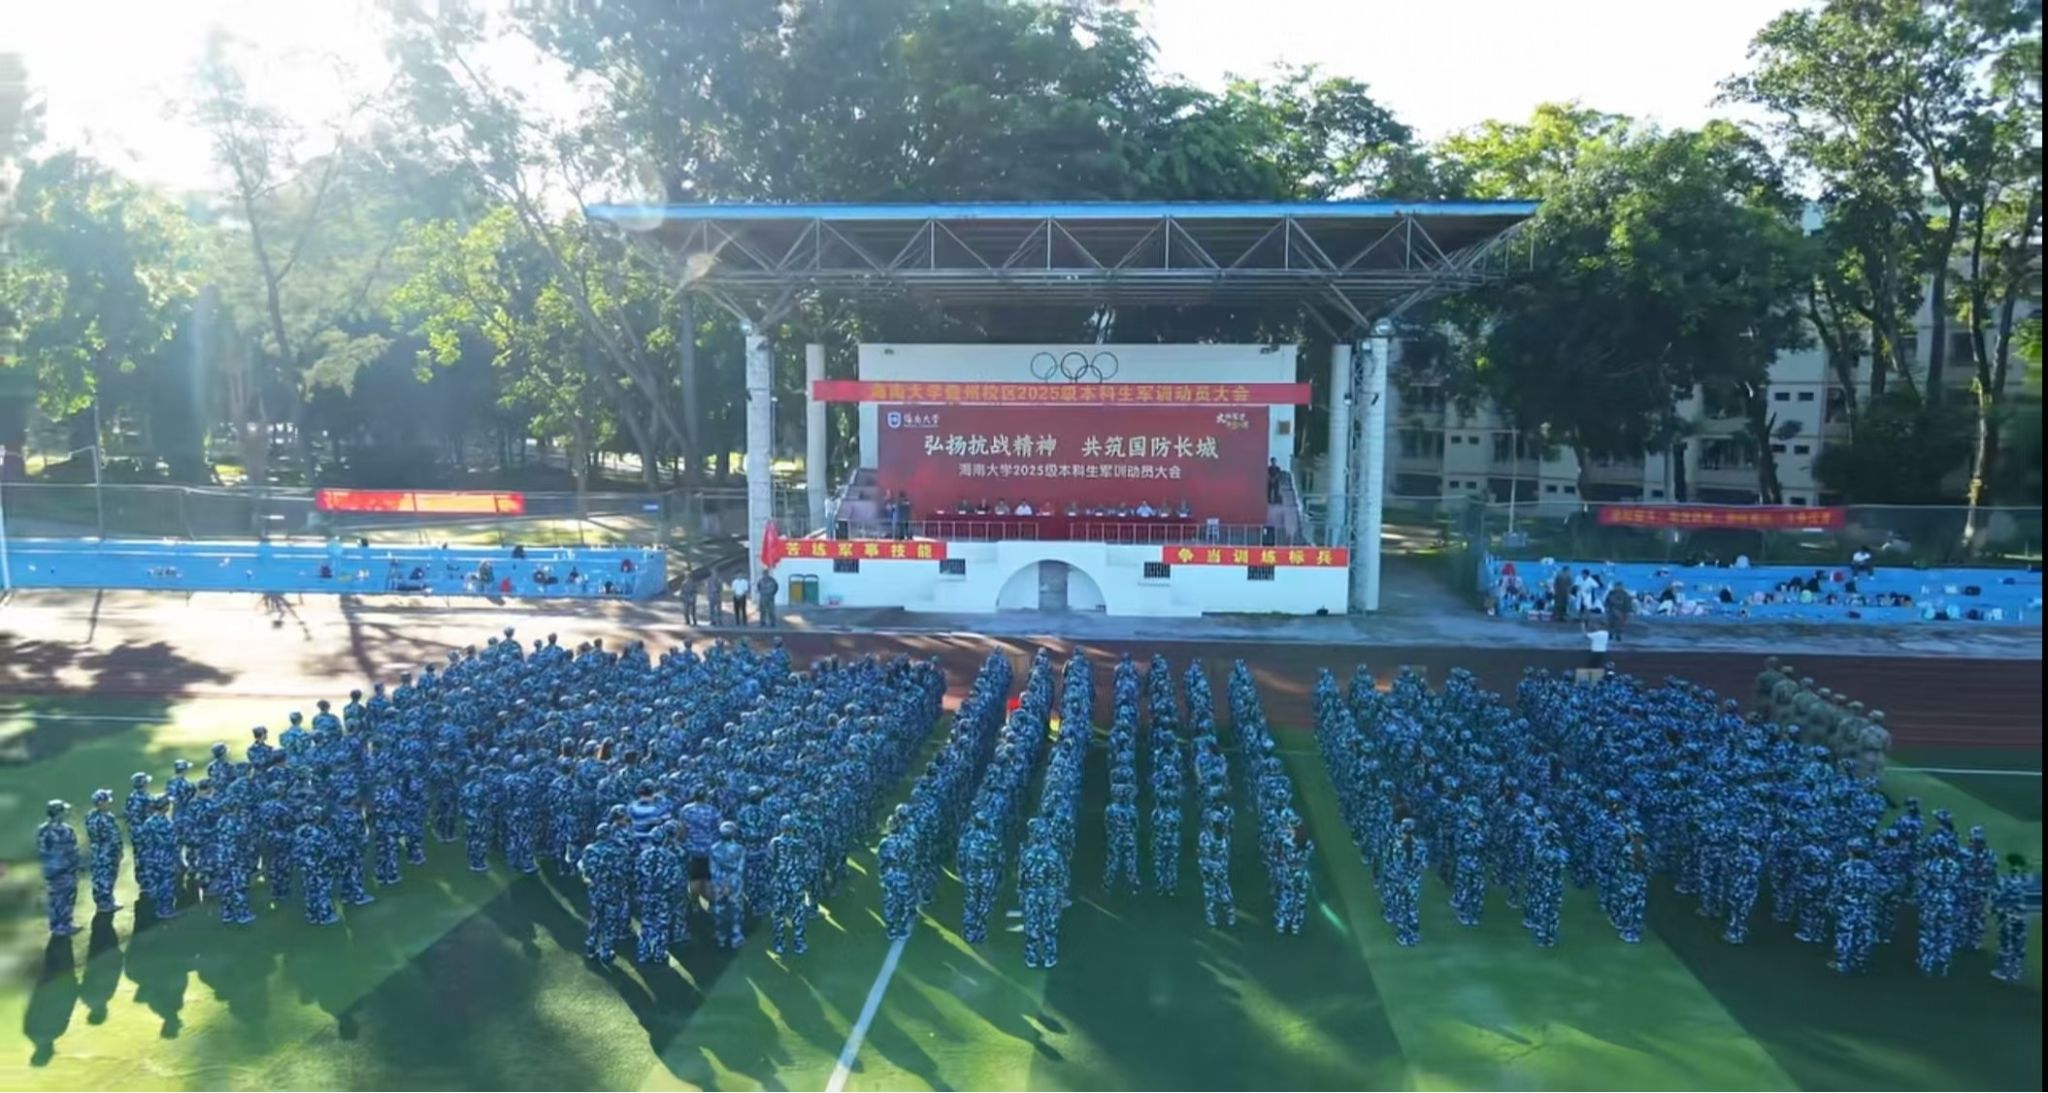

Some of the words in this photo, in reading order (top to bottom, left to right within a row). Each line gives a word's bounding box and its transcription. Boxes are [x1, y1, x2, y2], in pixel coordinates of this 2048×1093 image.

[924, 434, 1057, 457] 弘扬抗战精神
[1082, 434, 1220, 459] 共筑国防长城
[959, 463, 1182, 479] 海南大学2025级本科生军训动员大会
[785, 542, 932, 558] 苦练军事技能
[1177, 547, 1333, 565] 争当训练标兵
